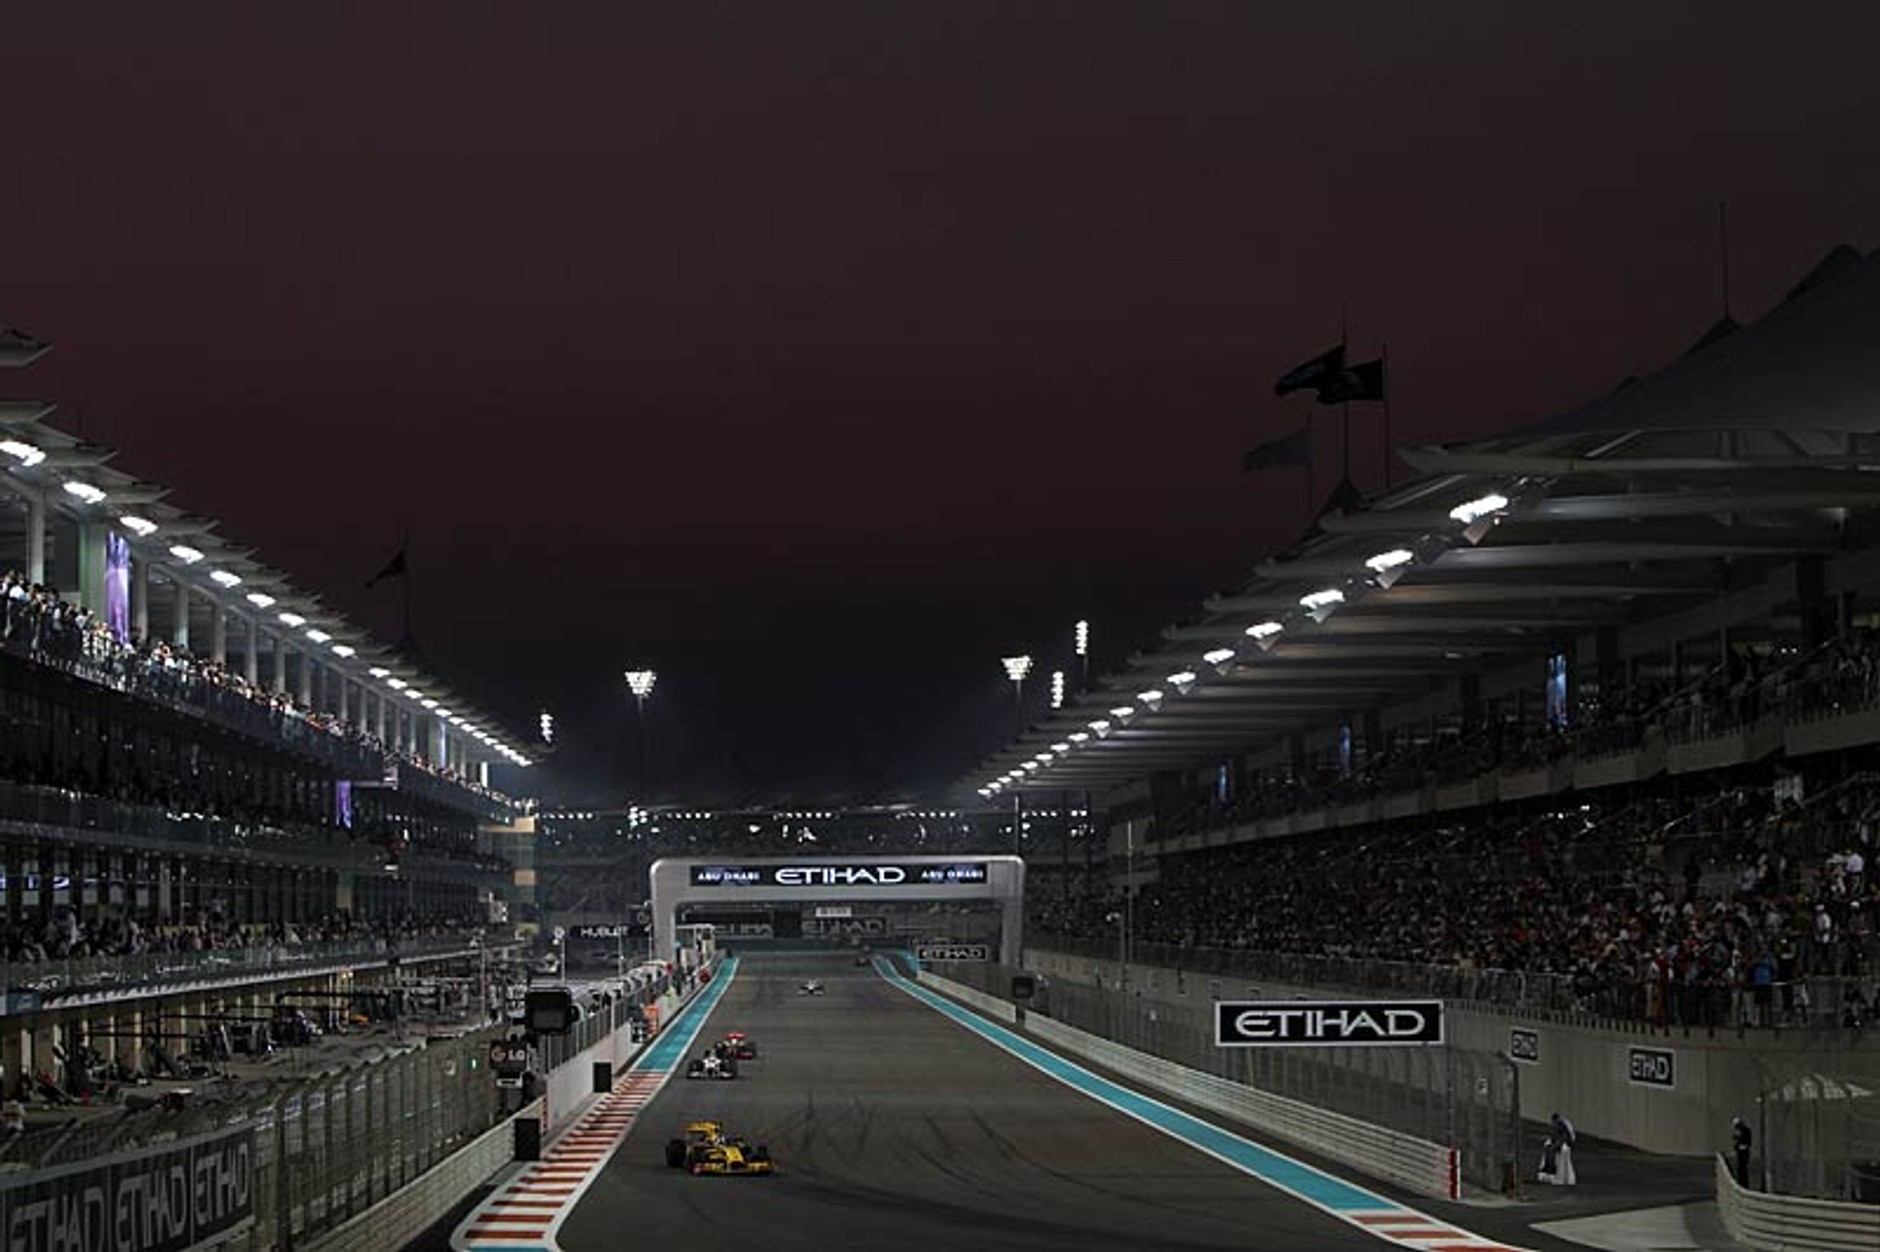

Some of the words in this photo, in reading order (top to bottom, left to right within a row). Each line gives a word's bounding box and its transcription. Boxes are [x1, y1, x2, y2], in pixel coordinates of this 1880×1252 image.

[697, 871, 721, 881] ABU
[724, 871, 760, 881] DHABI
[775, 866, 906, 885] ETIHAD
[1234, 1010, 1425, 1037] ETIHAD
